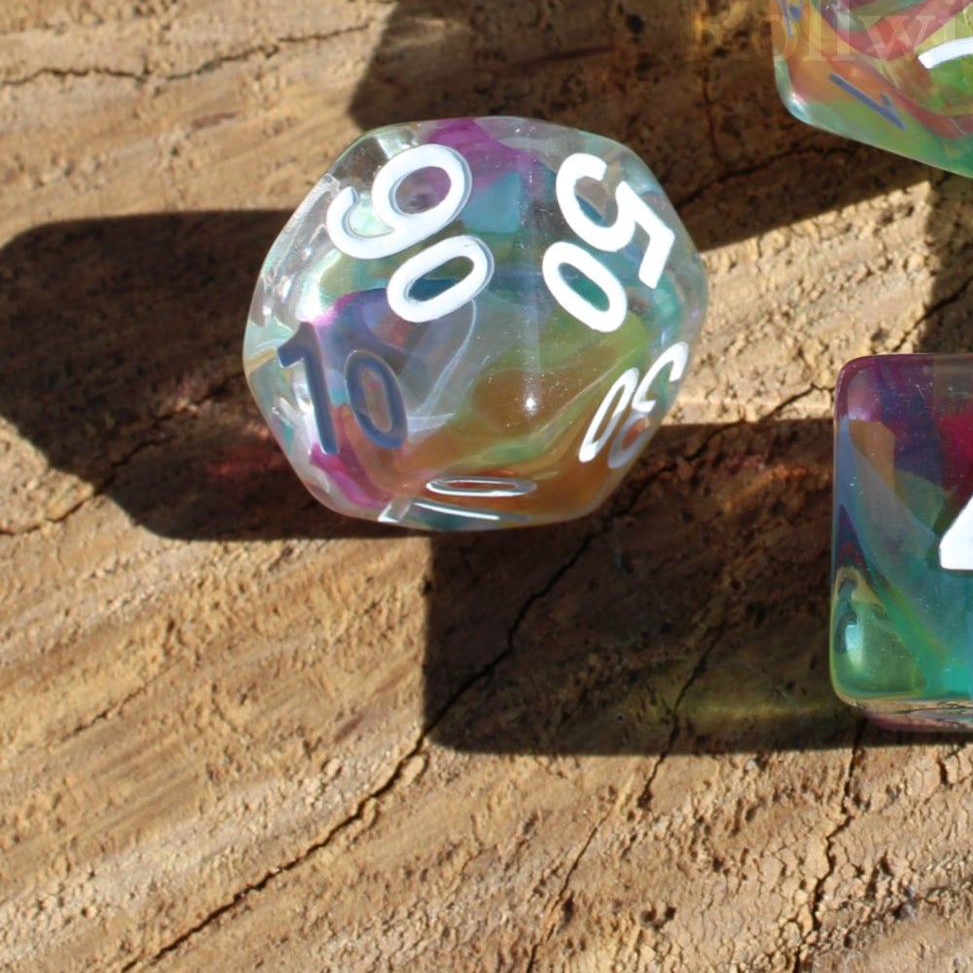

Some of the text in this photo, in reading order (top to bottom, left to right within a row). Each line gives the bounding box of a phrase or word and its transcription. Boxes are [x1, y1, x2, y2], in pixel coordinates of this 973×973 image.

[326, 143, 495, 323] 90
[542, 152, 675, 332] 50
[277, 322, 408, 456] 10
